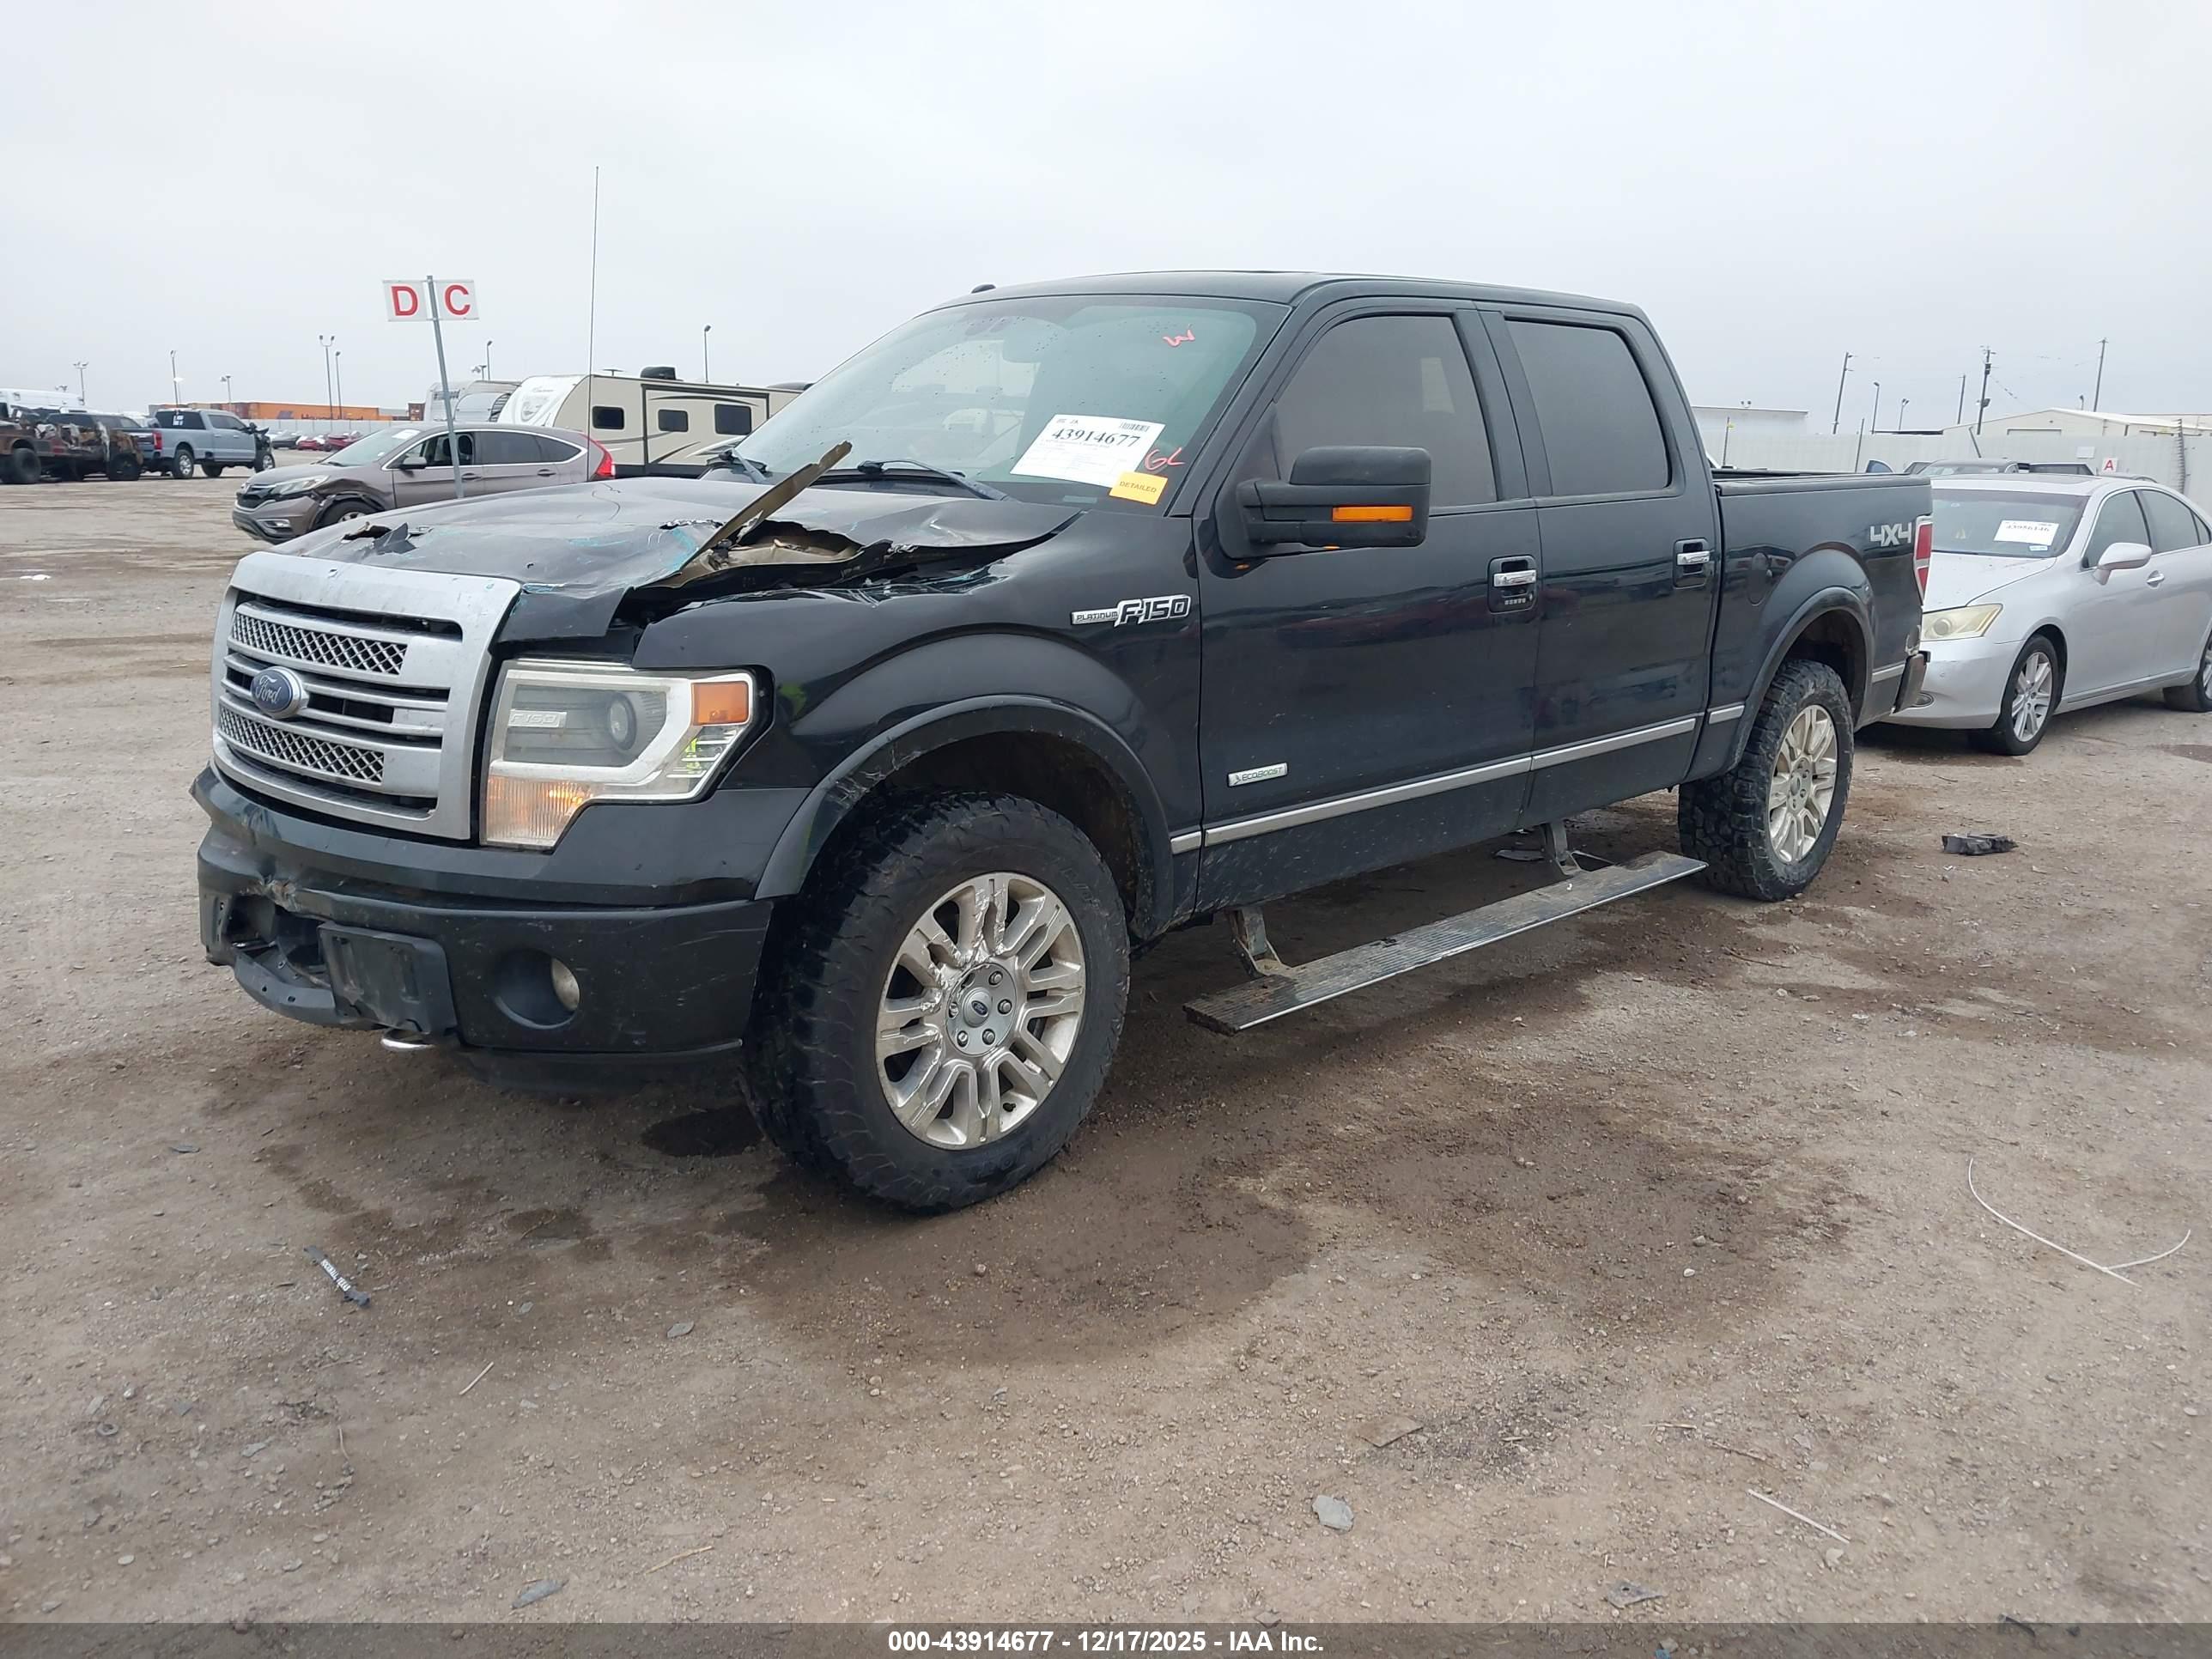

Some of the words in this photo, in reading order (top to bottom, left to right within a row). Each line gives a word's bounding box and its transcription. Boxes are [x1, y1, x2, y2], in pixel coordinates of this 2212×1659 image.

[391, 286, 418, 316] D
[444, 284, 471, 316] C
[1052, 428, 1141, 447] 43914677
[2103, 459, 2114, 471] A
[1119, 480, 1158, 494] DETAILED
[1076, 611, 1119, 621] PLATINUM
[255, 674, 283, 704] Ford
[1242, 767, 1283, 781] ECOBOOST
